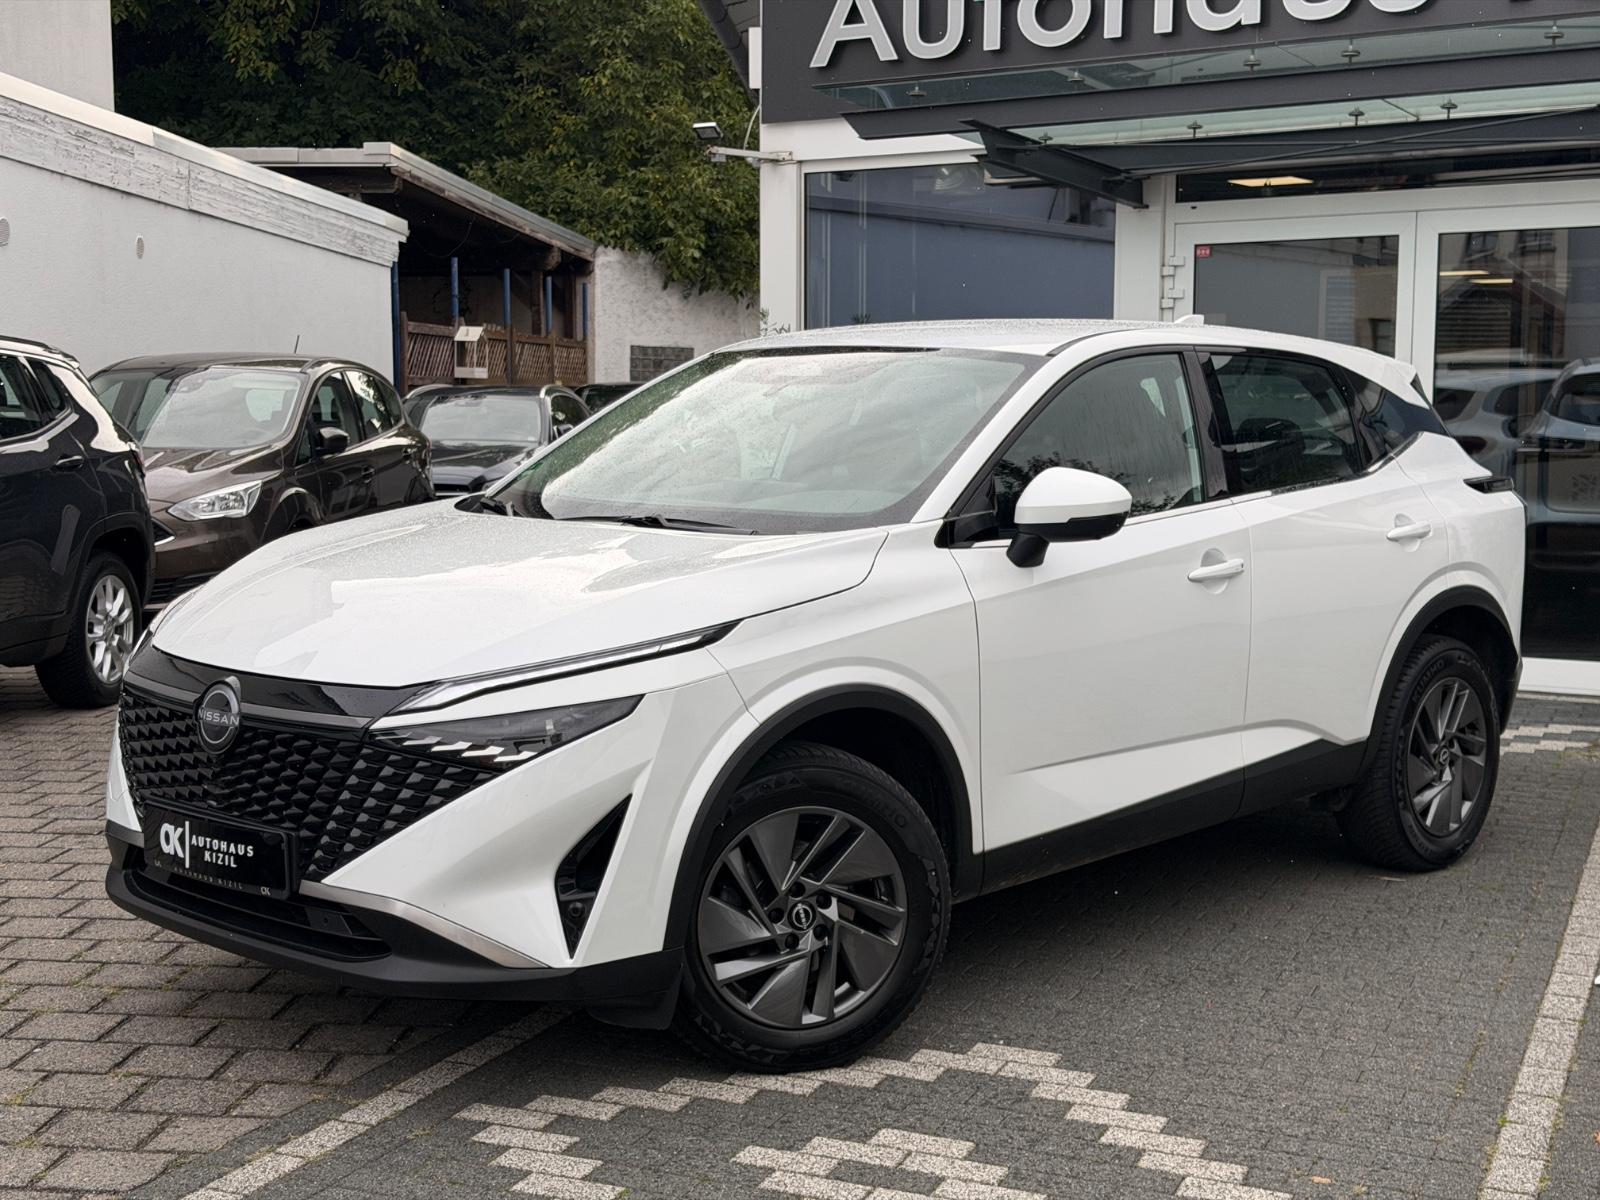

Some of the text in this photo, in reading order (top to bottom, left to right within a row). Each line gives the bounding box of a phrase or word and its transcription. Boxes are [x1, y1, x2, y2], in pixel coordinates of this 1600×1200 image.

[198, 708, 239, 725] NISSAN
[191, 834, 254, 857] AUTOHAUS
[204, 850, 238, 868] KIZIL
